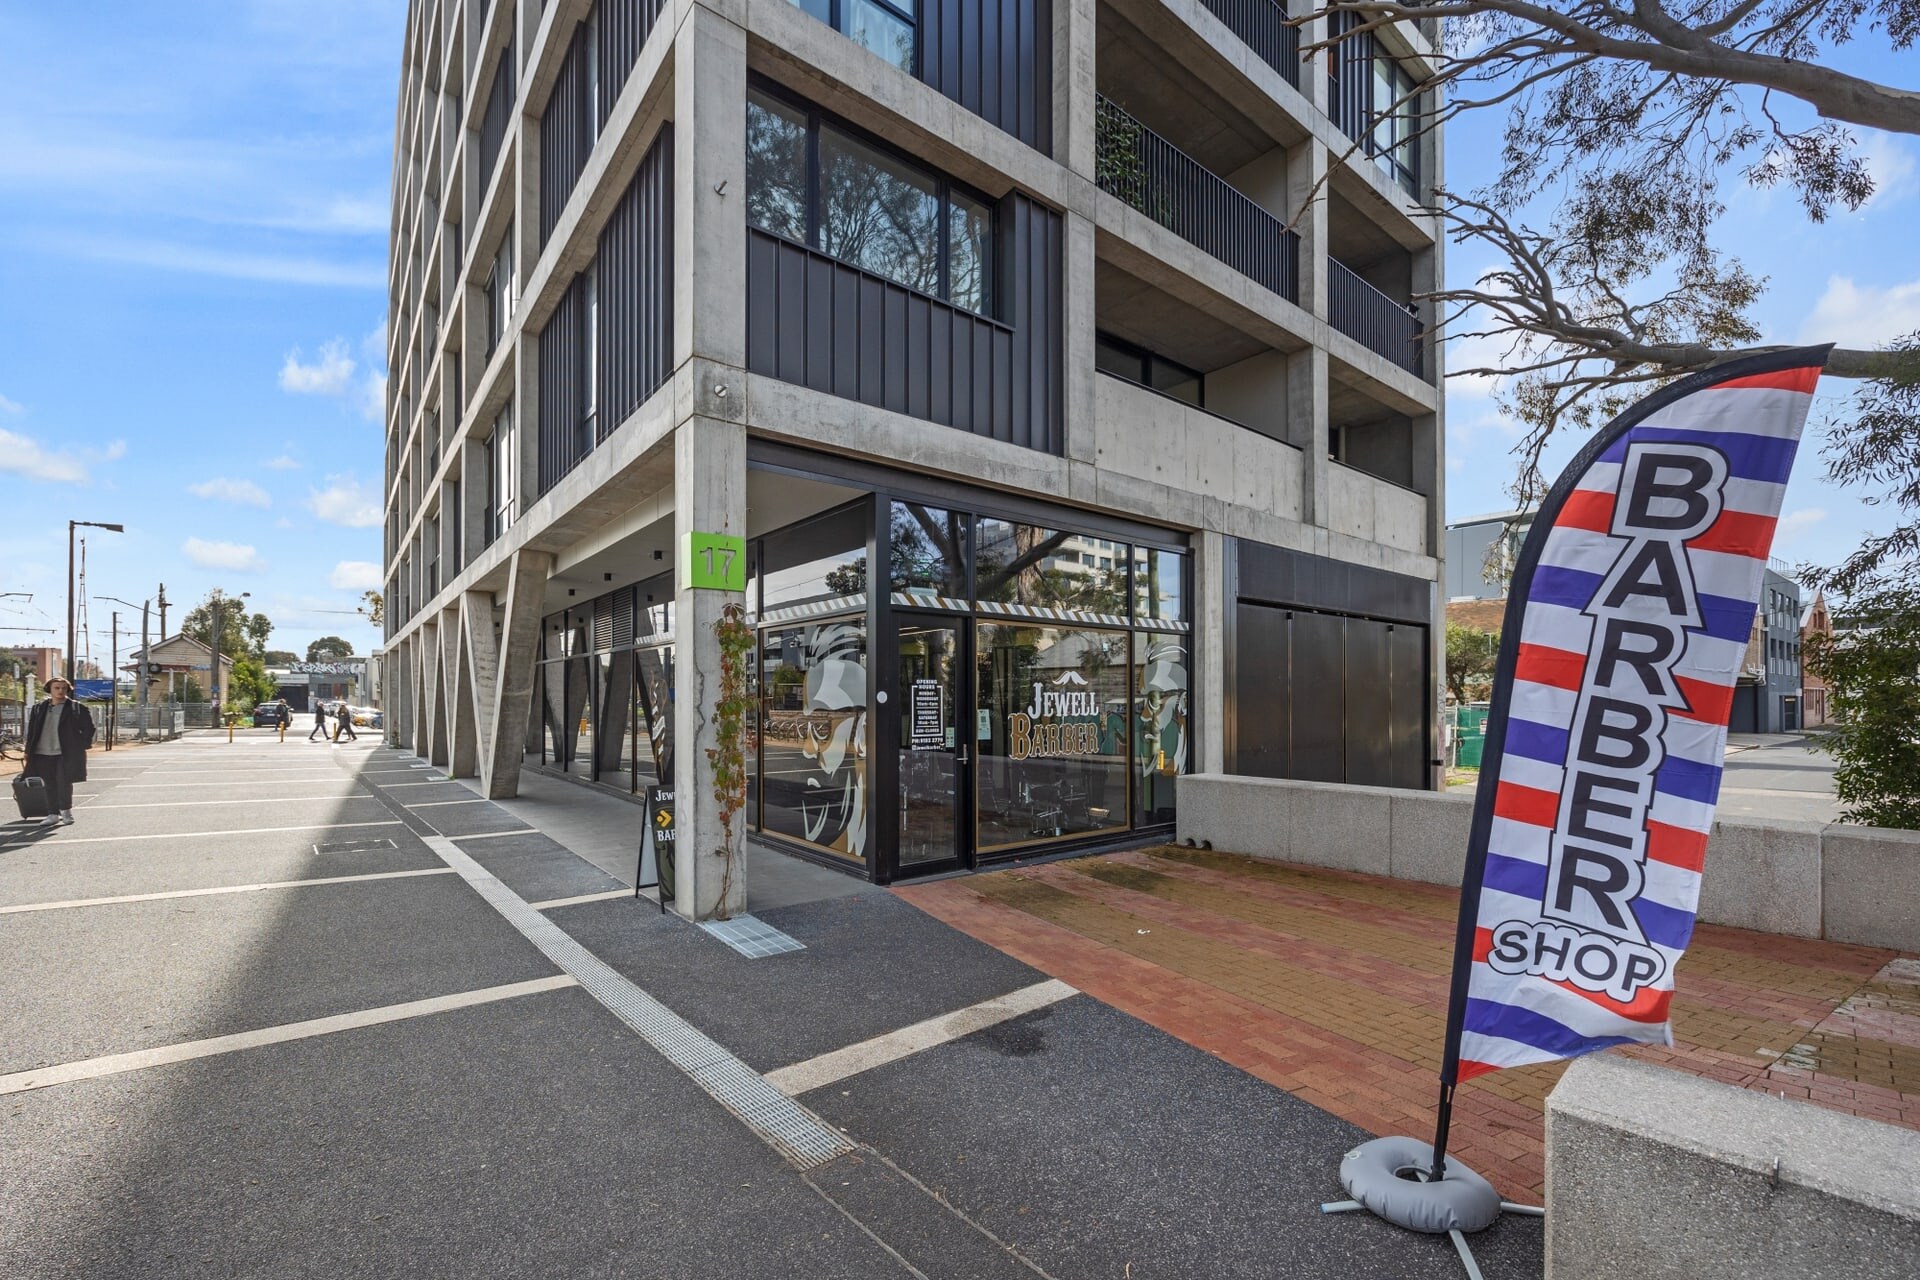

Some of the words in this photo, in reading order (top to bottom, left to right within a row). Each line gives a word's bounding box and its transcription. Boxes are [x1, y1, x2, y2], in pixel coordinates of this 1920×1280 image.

[699, 546, 736, 577] 17
[1027, 682, 1099, 719] JEWELL
[1552, 451, 1715, 932] BARBER
[1007, 712, 1100, 760] BARBER
[1494, 930, 1658, 993] SHOP
